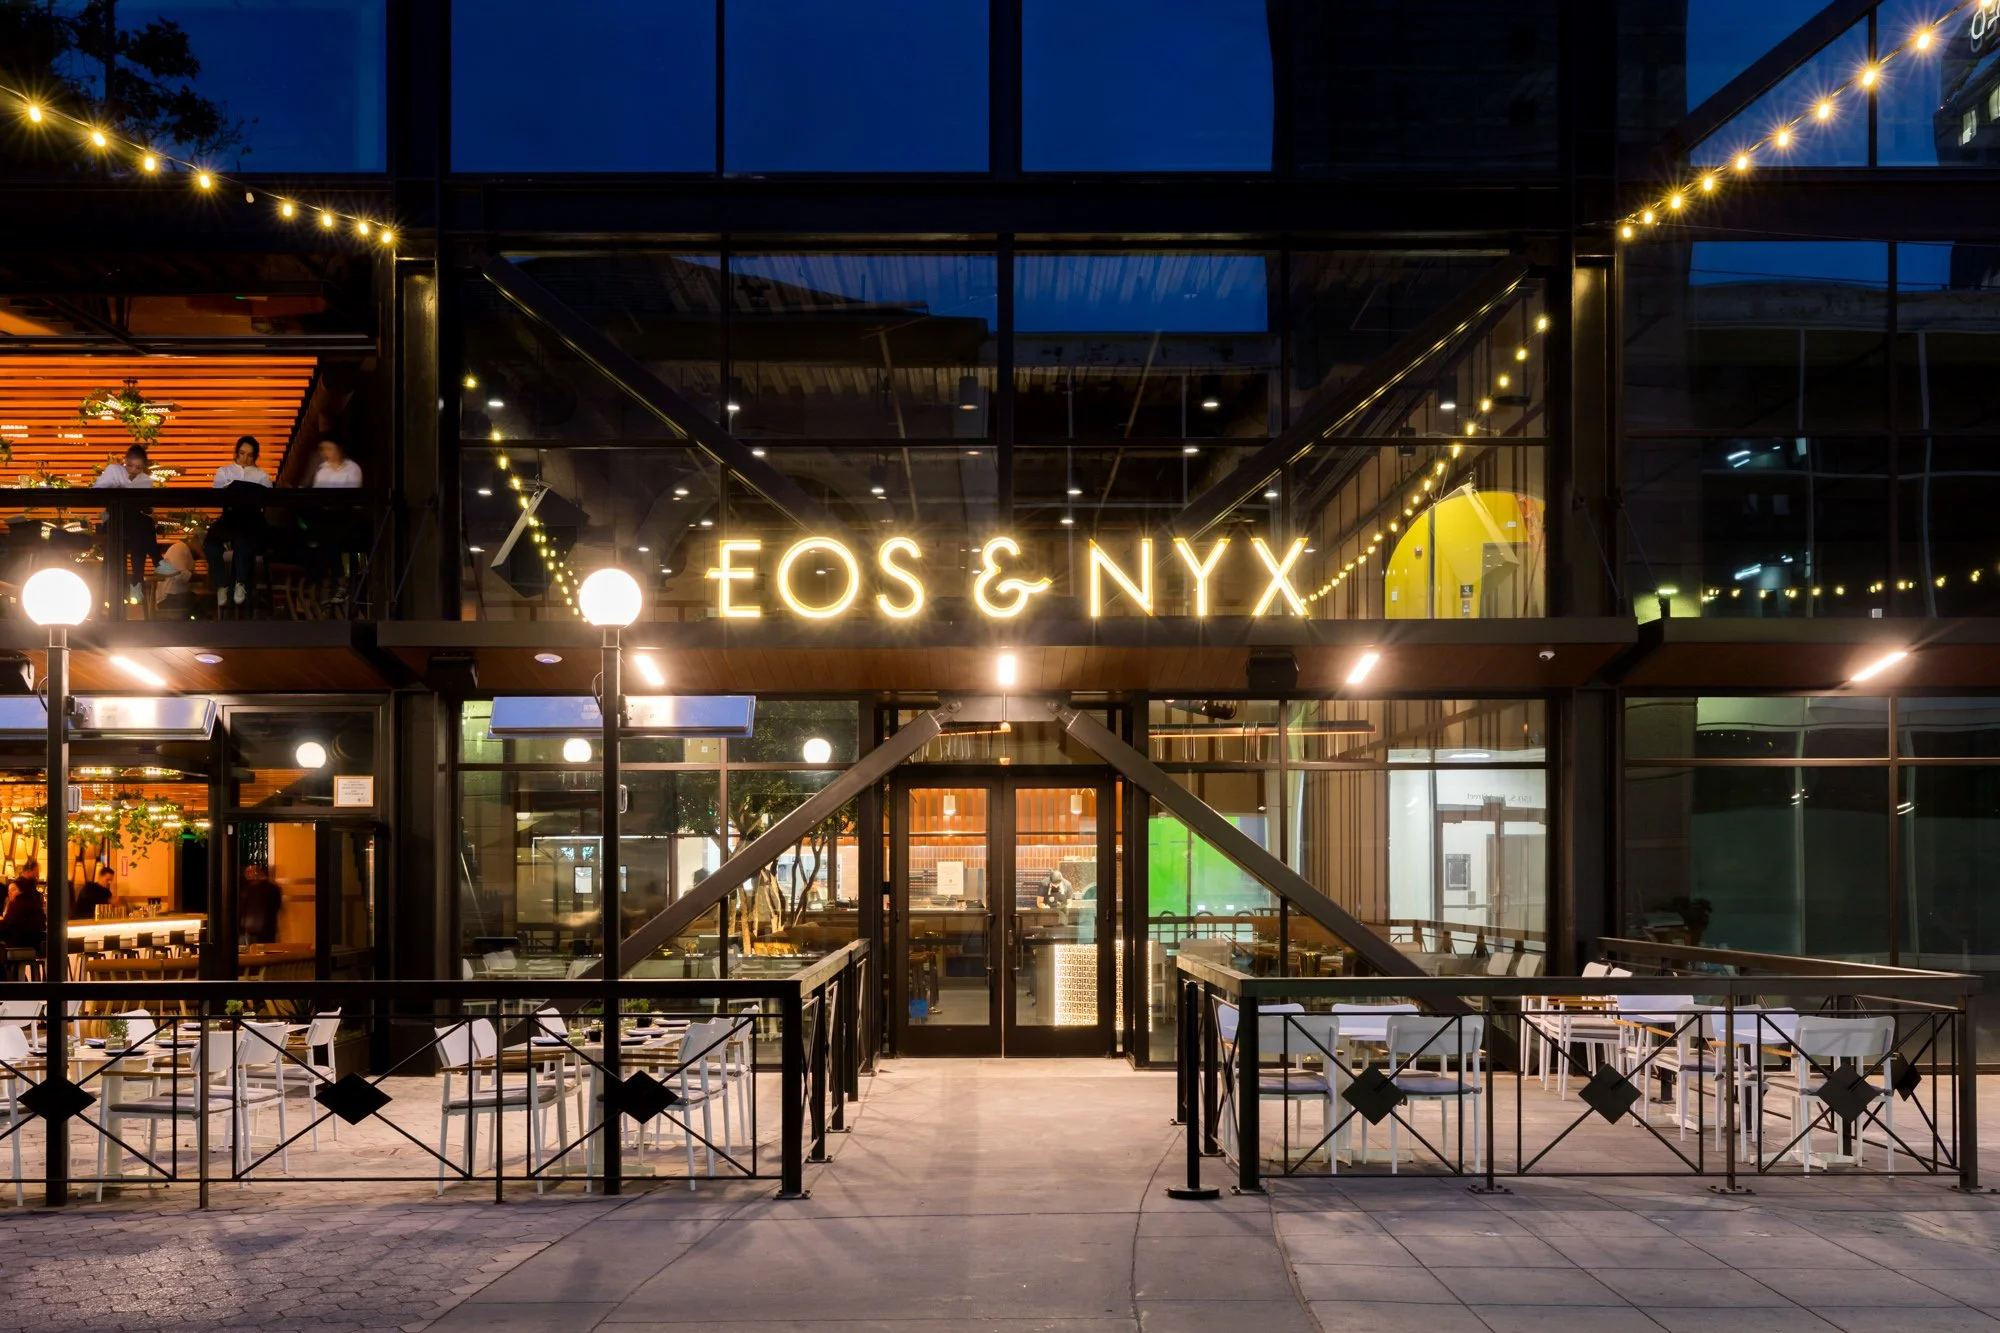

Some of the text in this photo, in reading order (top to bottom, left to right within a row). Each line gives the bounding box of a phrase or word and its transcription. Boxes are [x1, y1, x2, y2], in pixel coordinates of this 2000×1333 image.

[705, 536, 1311, 619] EOS & NYX
